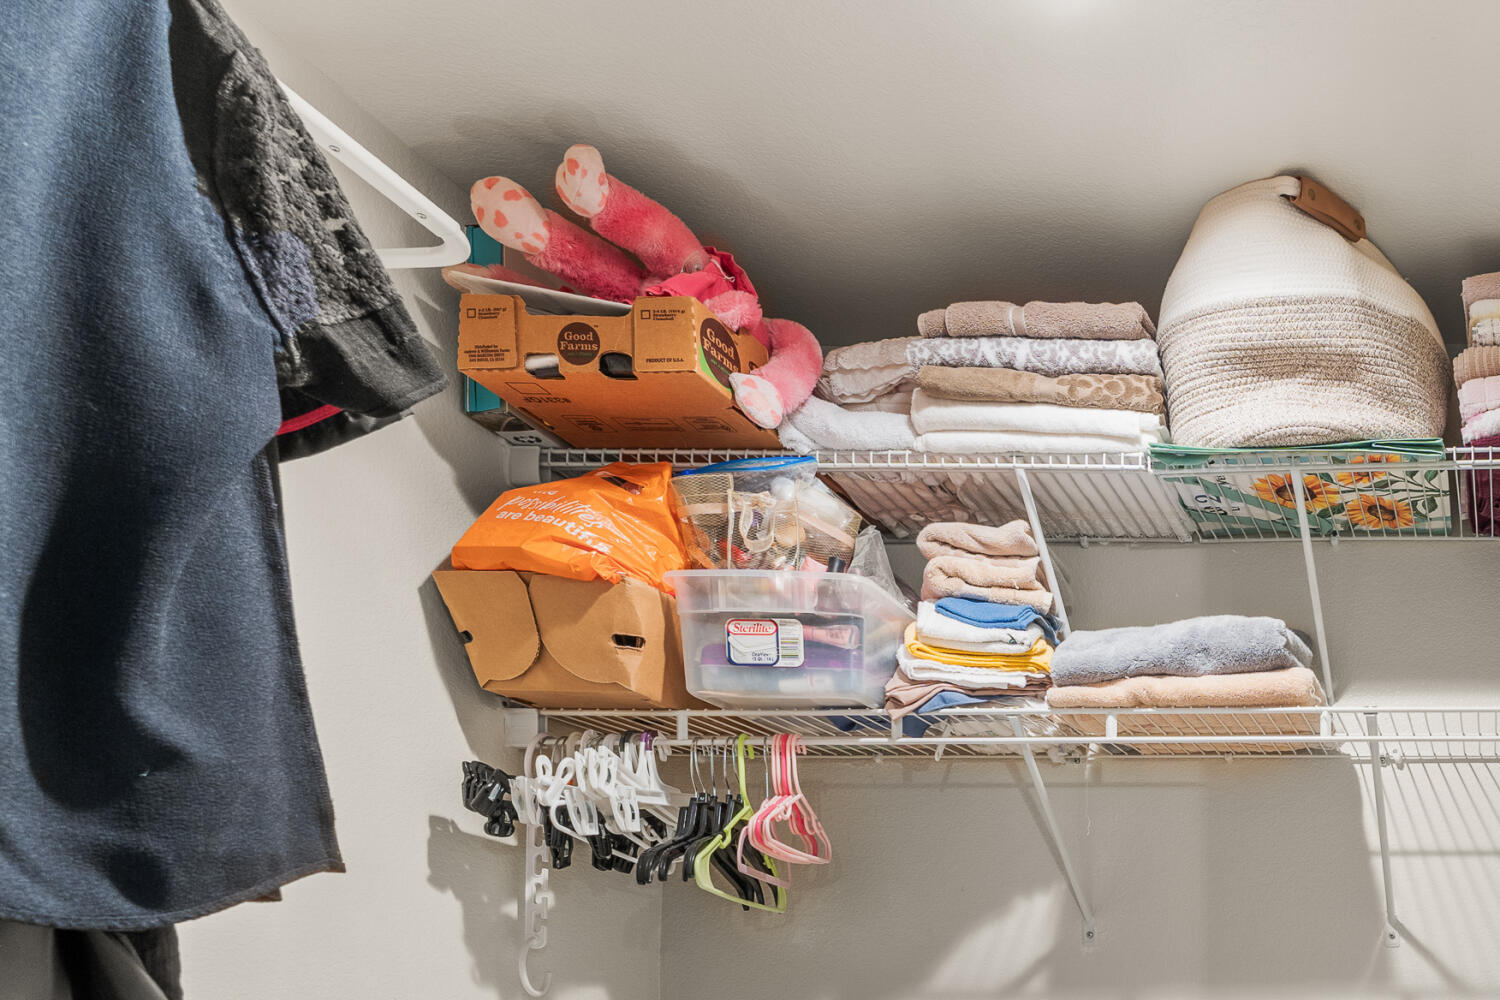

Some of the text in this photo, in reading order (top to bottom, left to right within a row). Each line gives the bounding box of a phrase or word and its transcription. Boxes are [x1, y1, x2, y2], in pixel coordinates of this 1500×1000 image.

[563, 331, 594, 341] Good
[559, 341, 599, 351] Farms
[706, 327, 736, 361] Good
[702, 336, 739, 373] Farms
[495, 510, 523, 520] are
[732, 622, 775, 633] Sterilite
